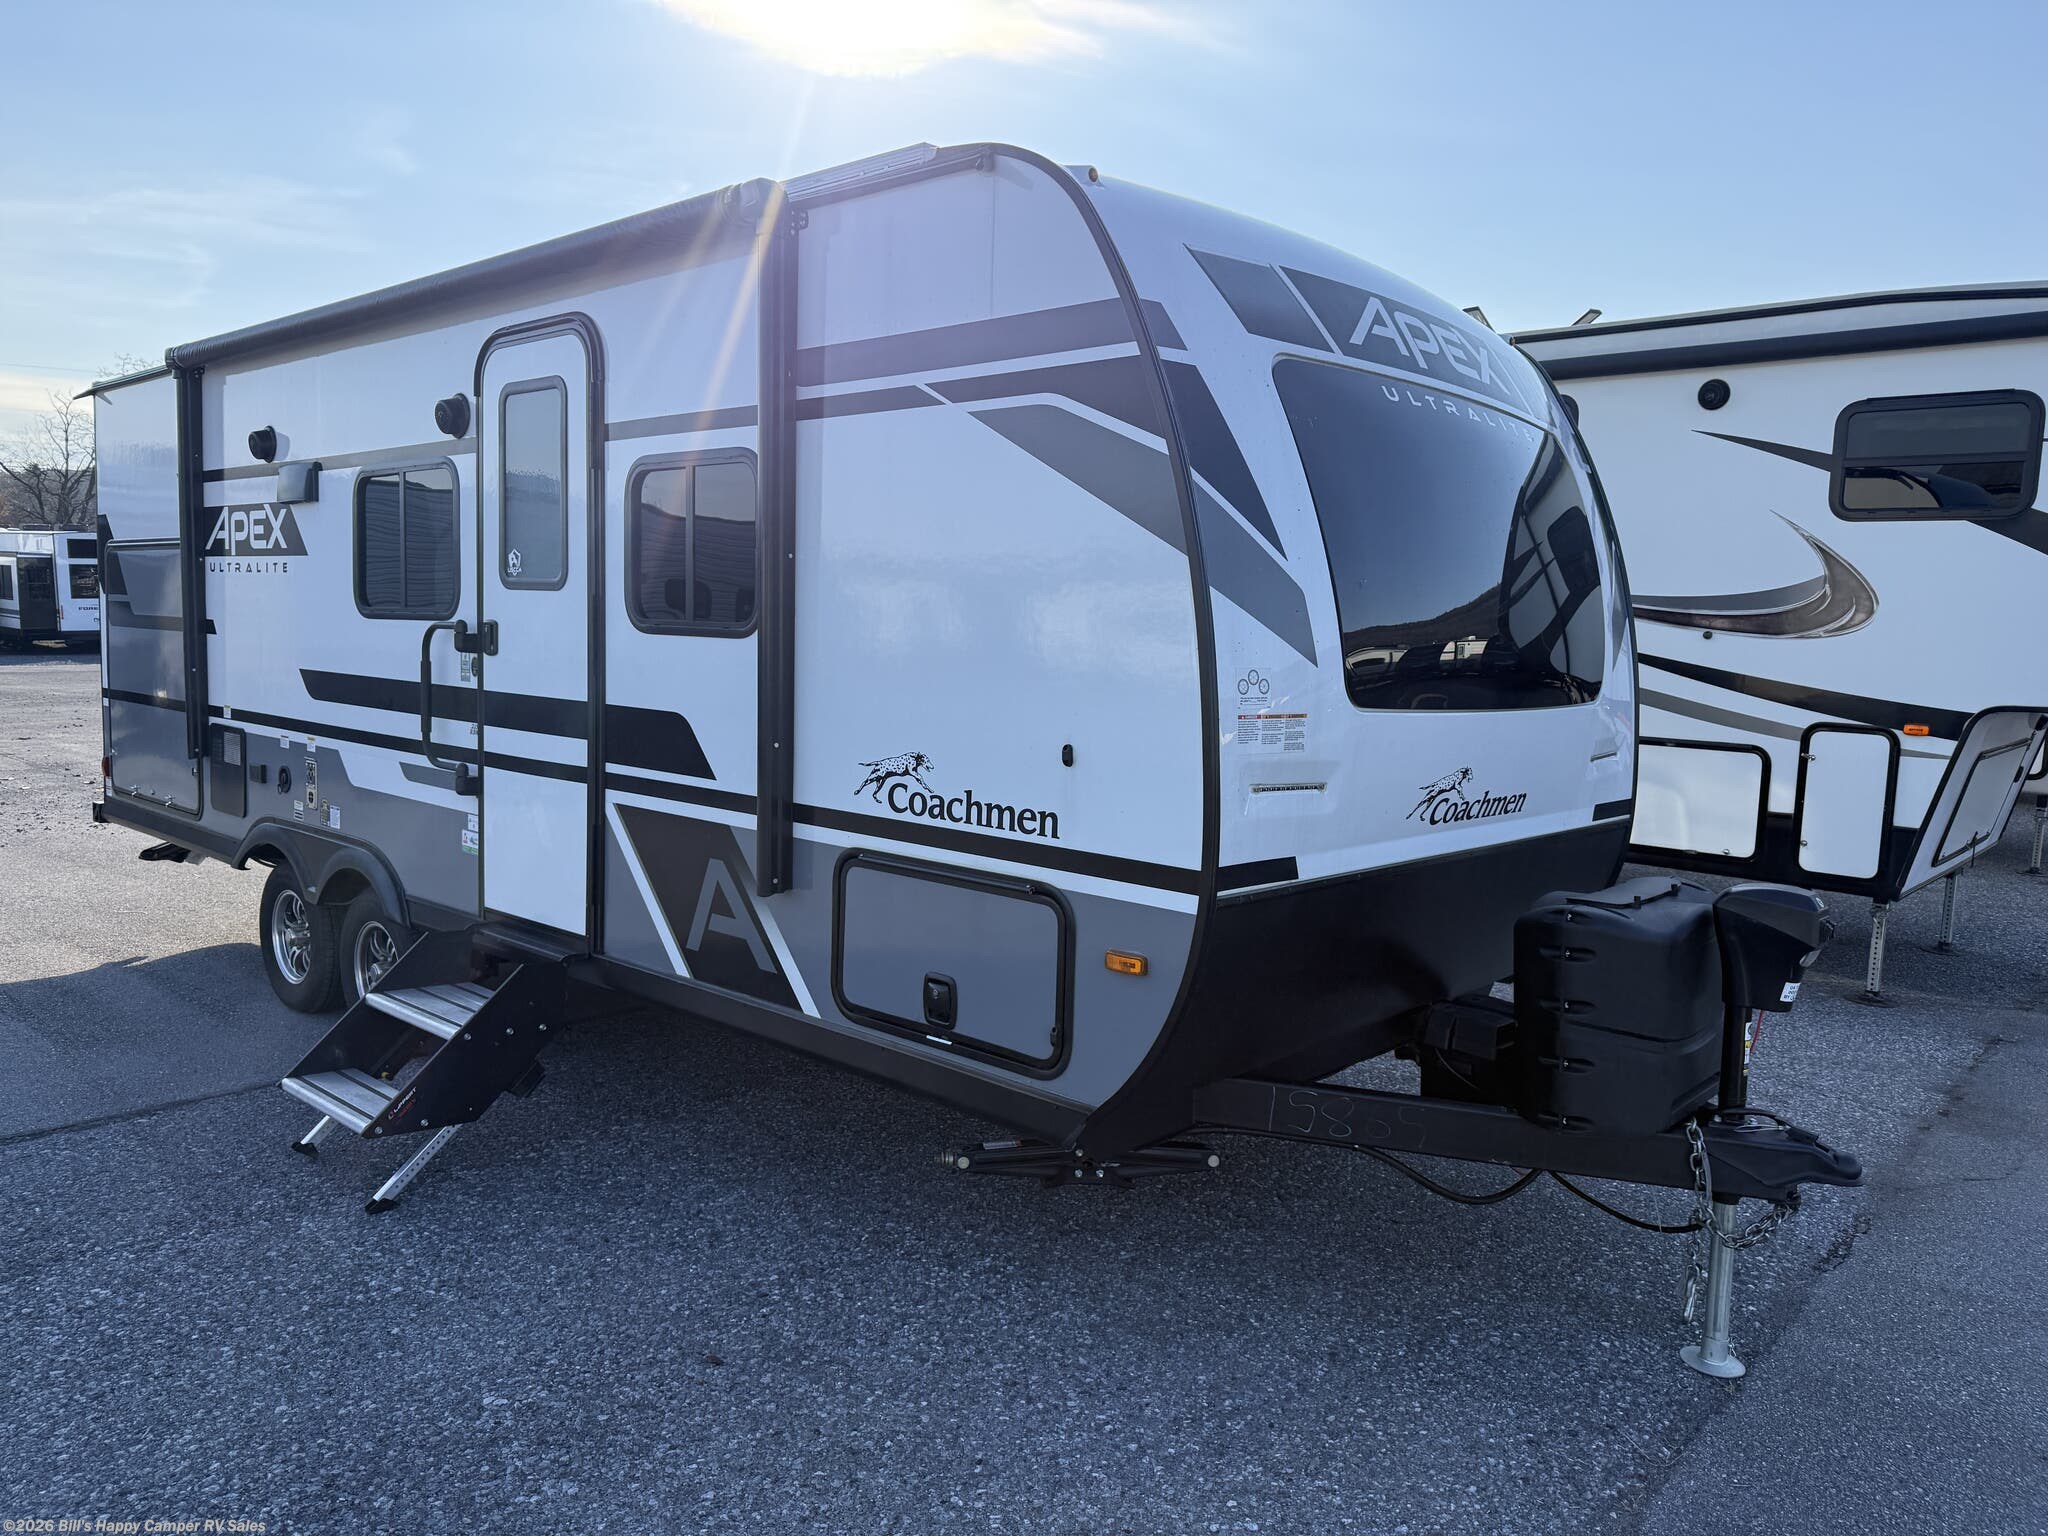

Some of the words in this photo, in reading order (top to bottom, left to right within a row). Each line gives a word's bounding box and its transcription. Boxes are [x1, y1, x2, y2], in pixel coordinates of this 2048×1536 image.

[1349, 296, 1511, 396] APEX
[1381, 385, 1536, 443] ULTRALITE
[205, 503, 288, 556] APEX
[209, 562, 289, 573] ULTRALITE
[887, 782, 1060, 839] Coachmen
[1429, 790, 1527, 826] Coachmen
